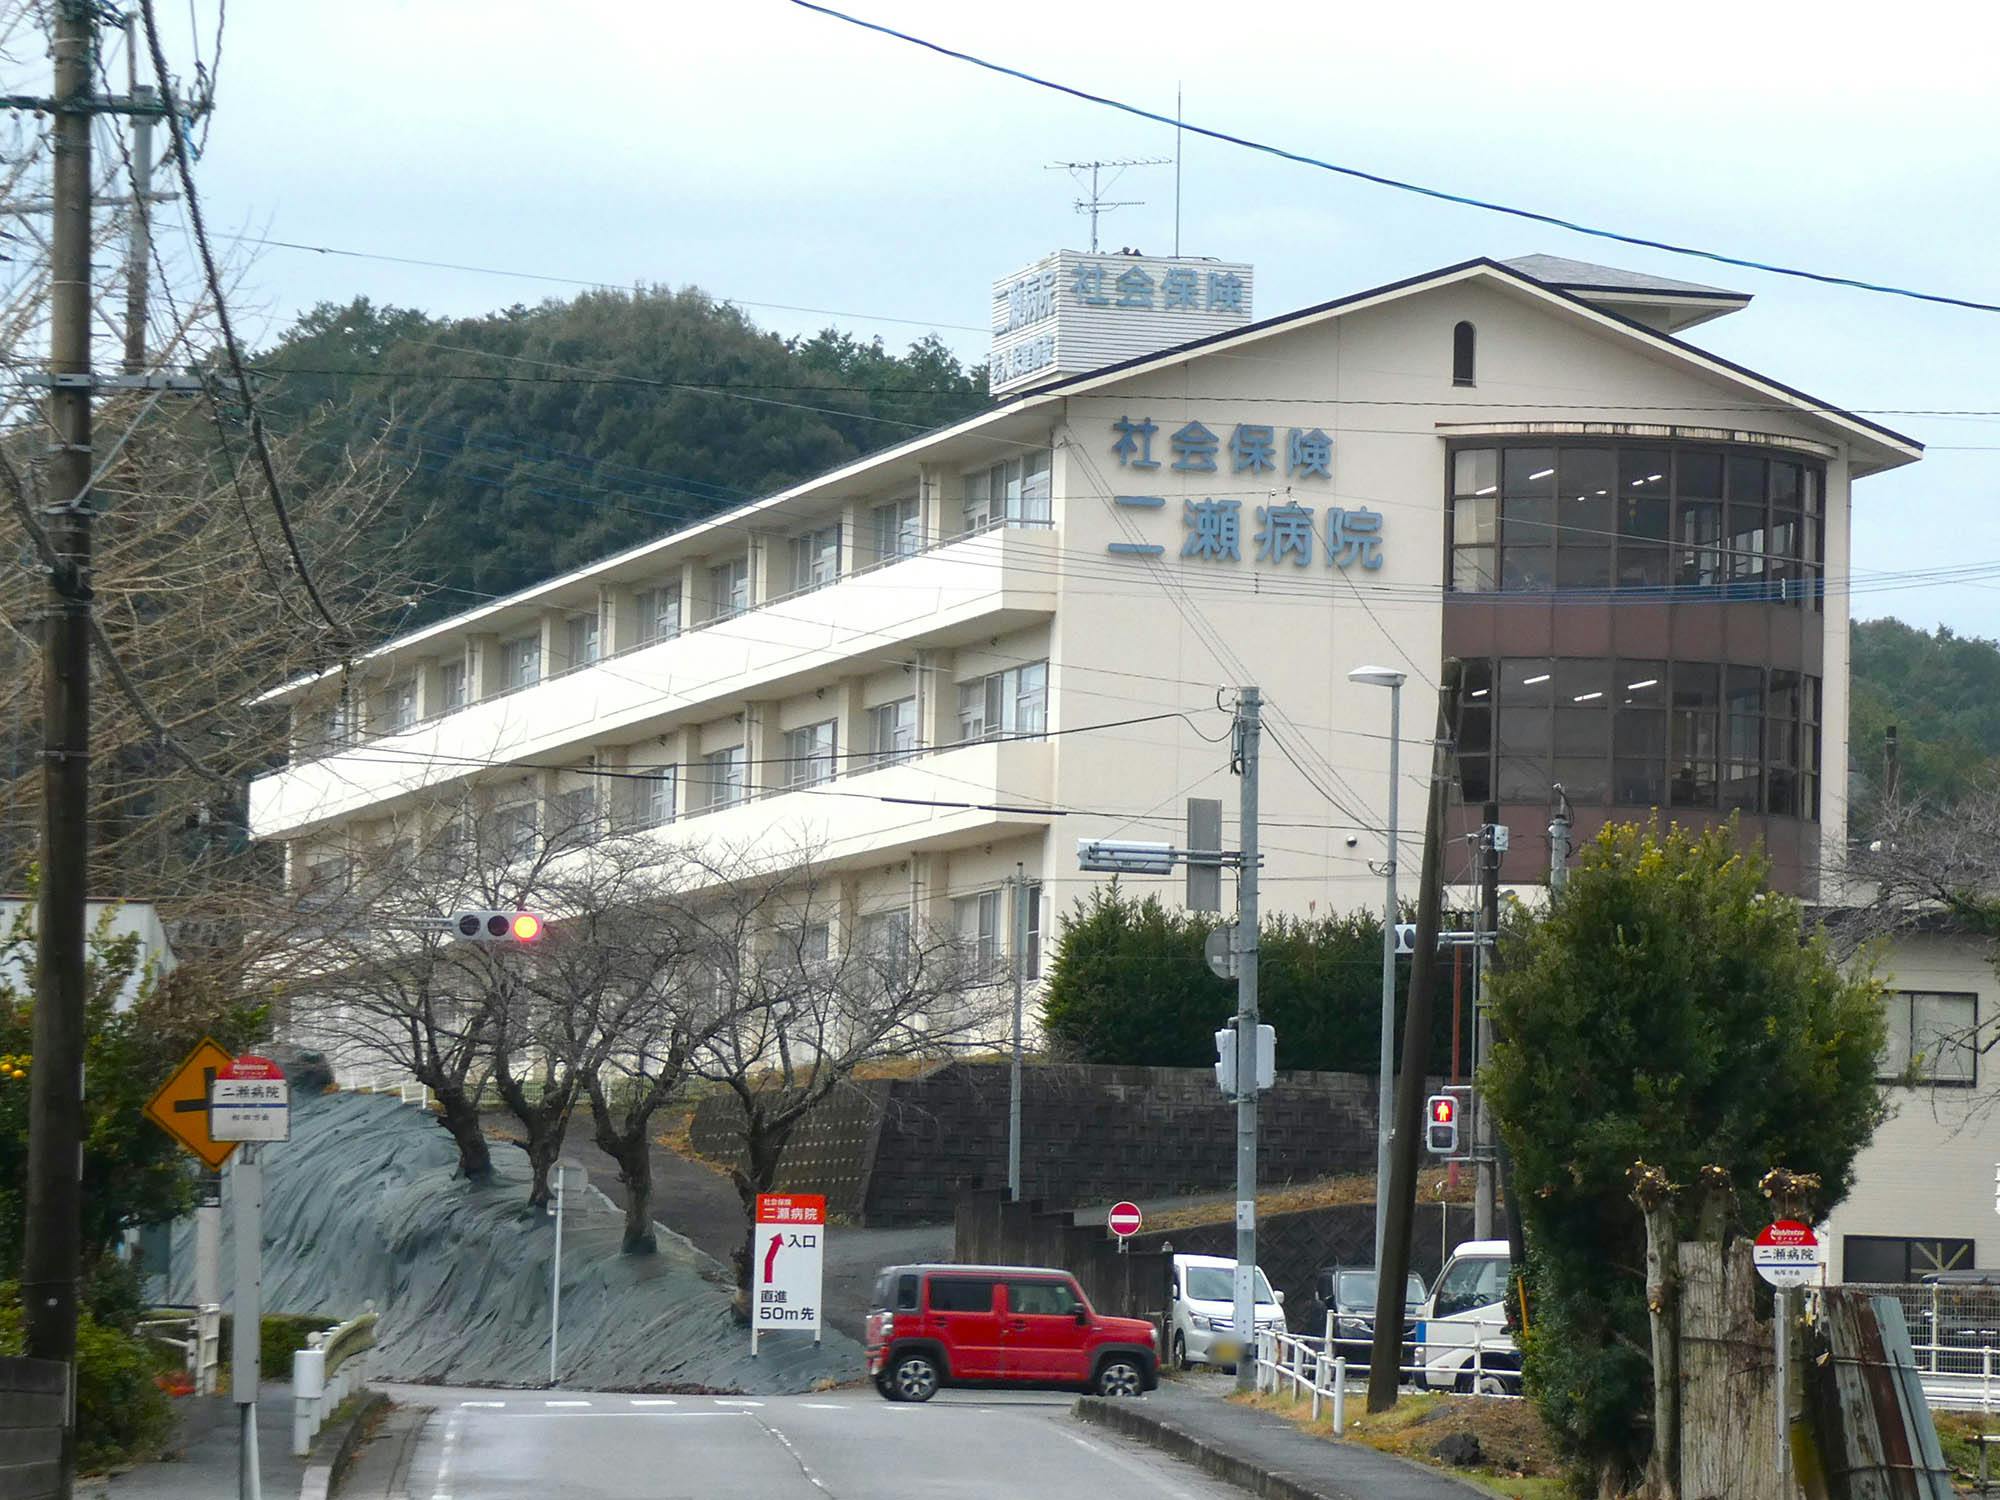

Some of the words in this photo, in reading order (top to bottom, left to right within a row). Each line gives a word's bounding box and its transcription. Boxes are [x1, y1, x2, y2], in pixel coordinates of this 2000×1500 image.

[1070, 262, 1243, 313] 社会保険
[1112, 415, 1333, 480] 社会保険
[1108, 496, 1384, 570] 二瀬病院
[221, 1086, 280, 1099] 二瀬病院
[763, 1207, 818, 1221] 二瀬病院
[788, 1234, 816, 1248] 入口
[1759, 1248, 1814, 1261] 二瀬病院
[760, 1290, 788, 1303] 直進
[760, 1306, 814, 1321] 50m先
